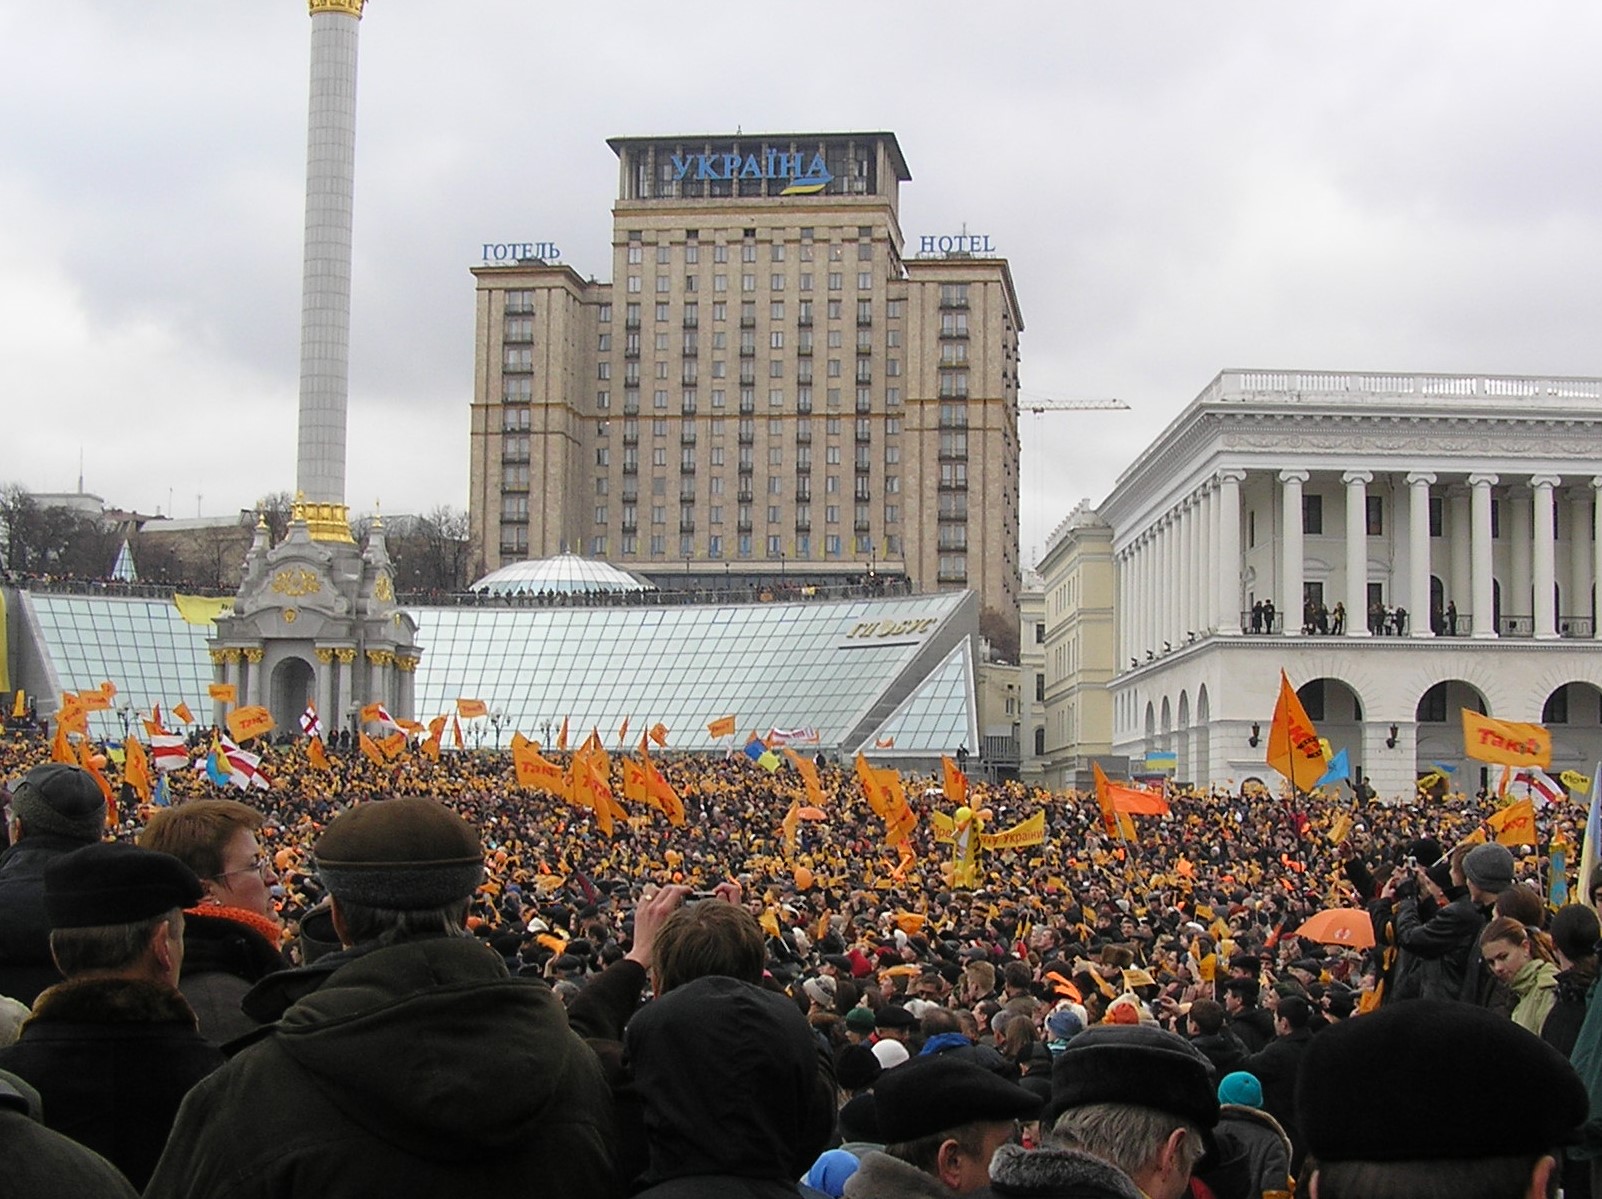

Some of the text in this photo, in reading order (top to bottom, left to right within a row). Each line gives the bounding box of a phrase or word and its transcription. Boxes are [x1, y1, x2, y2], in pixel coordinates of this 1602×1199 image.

[671, 148, 833, 181] УКРАЇНА
[482, 242, 560, 261] ГОТЕЛЬ
[920, 235, 996, 253] HOTEL
